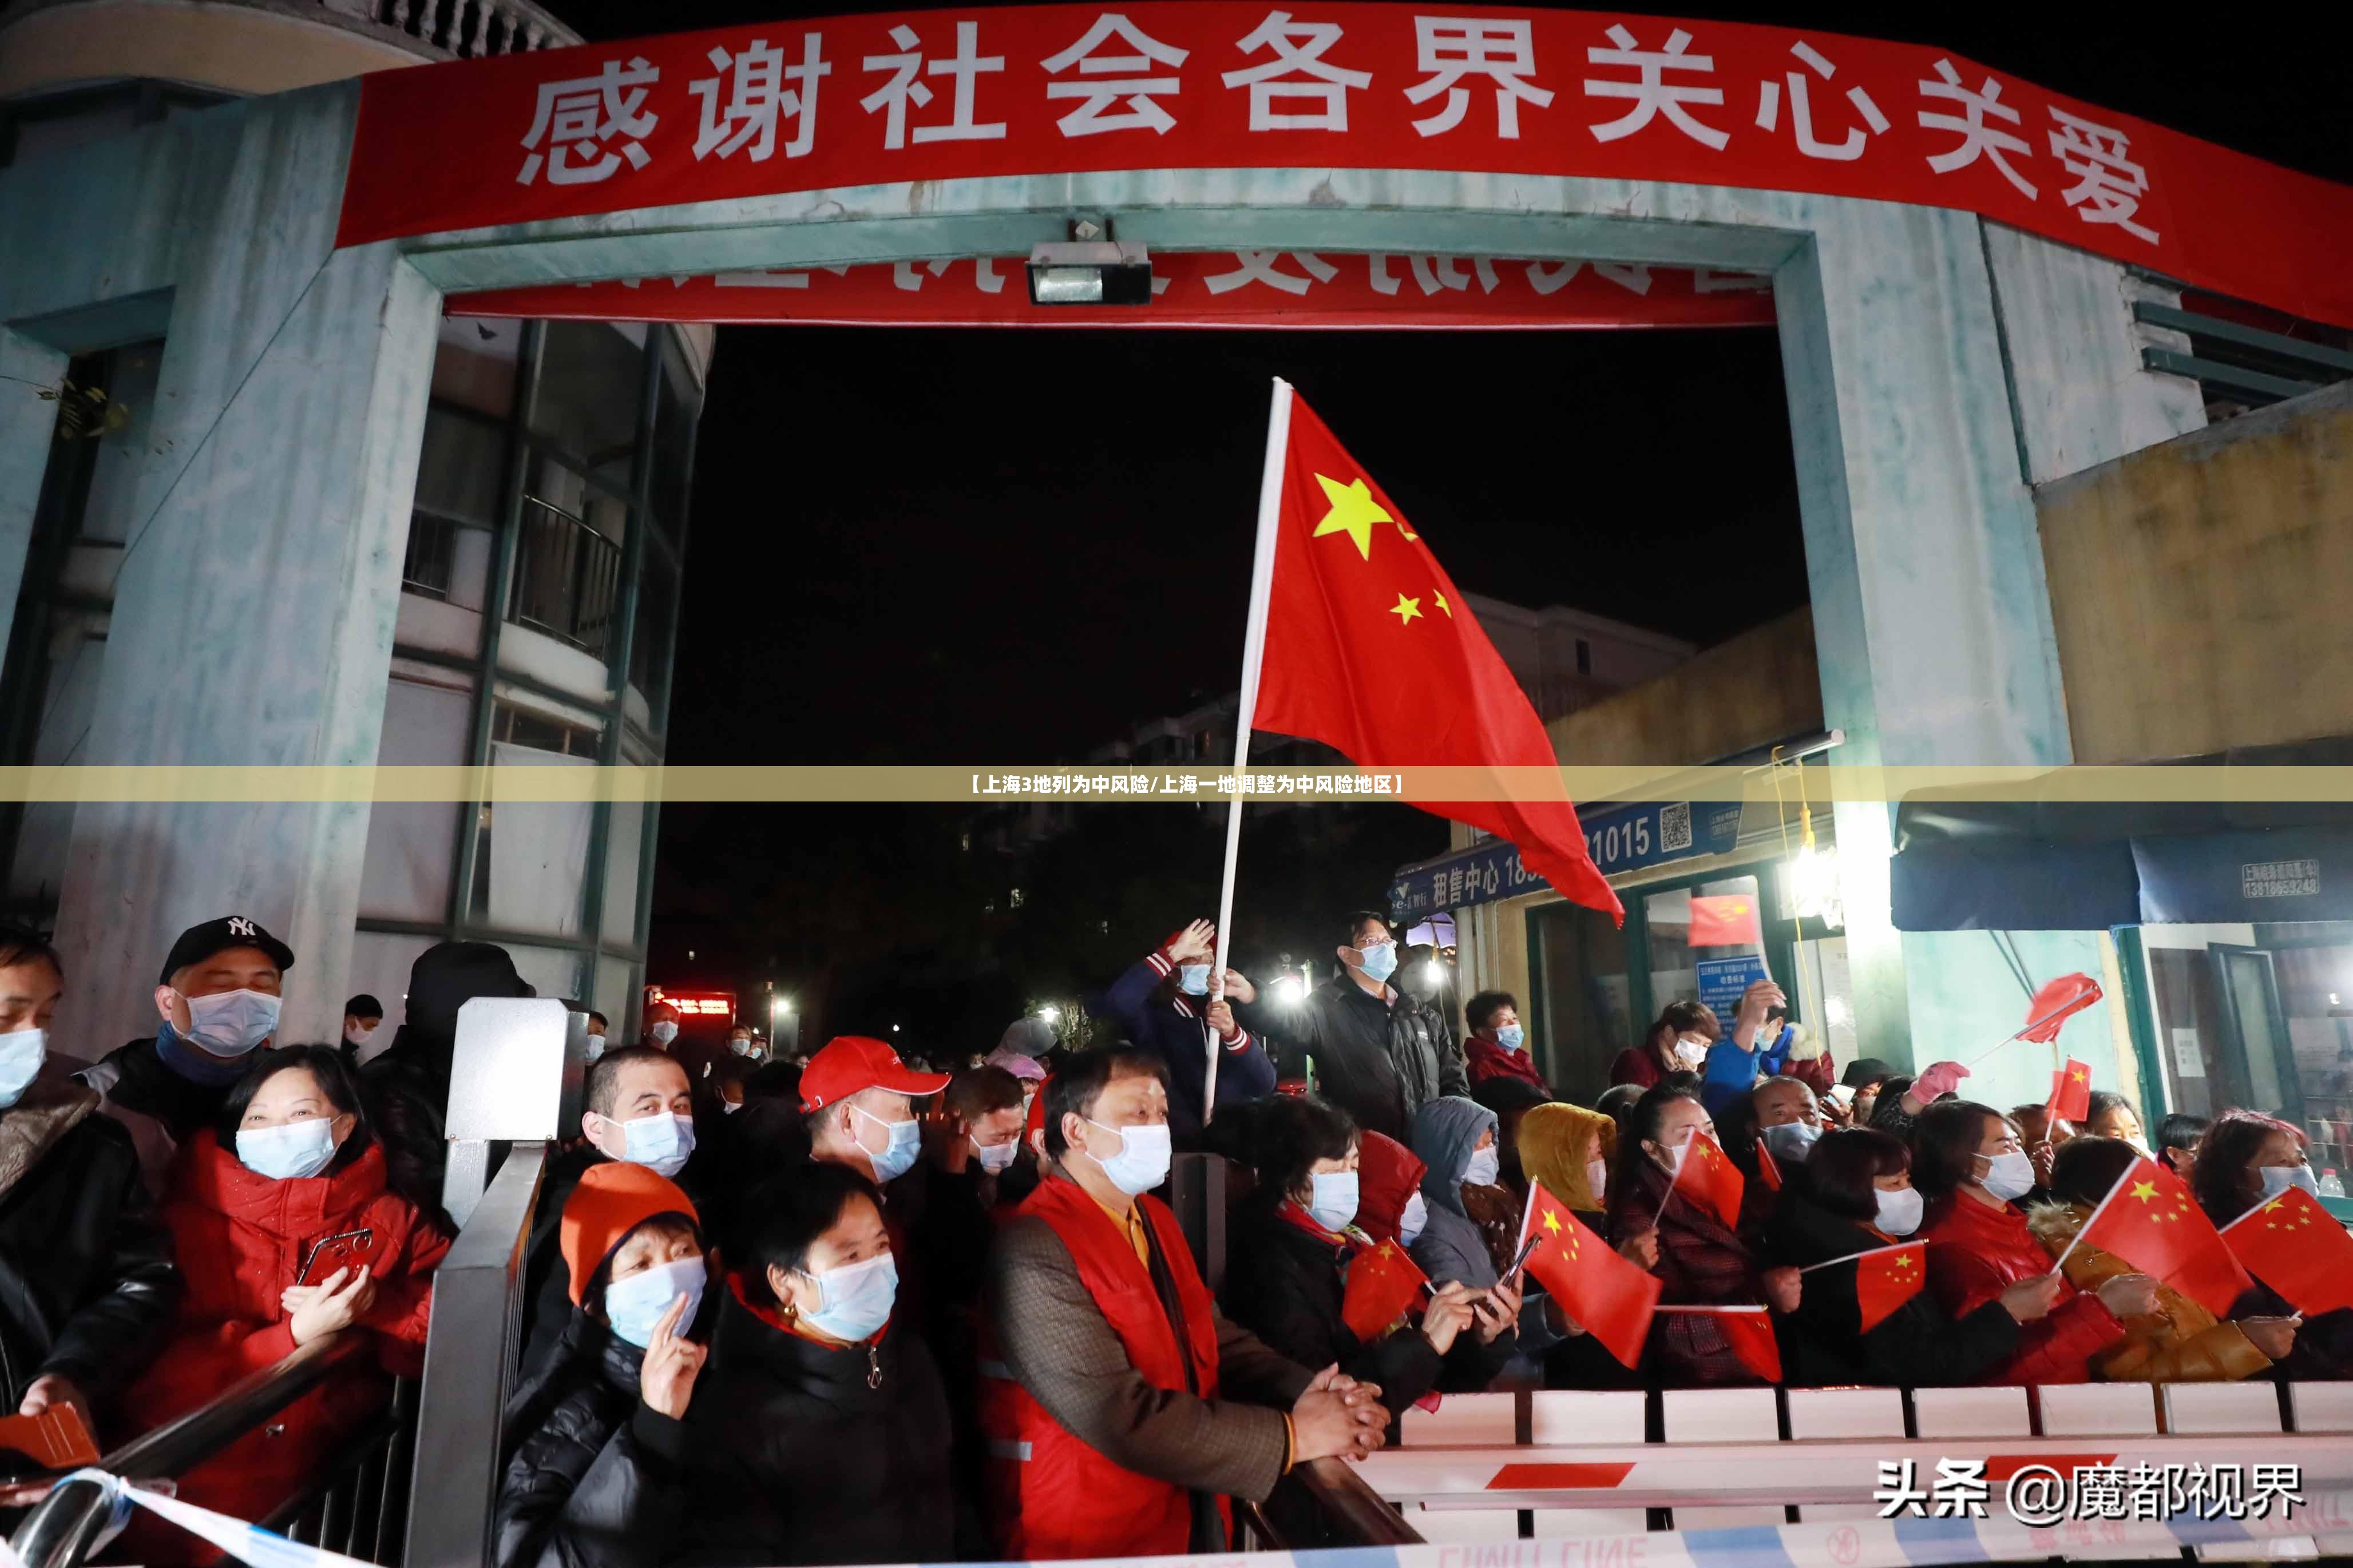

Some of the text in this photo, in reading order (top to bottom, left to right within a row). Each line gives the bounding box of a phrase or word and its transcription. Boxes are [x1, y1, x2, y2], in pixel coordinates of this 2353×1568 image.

[517, 10, 2160, 245] 感谢社会各界关心关爱
[1433, 859, 1499, 908] 租售中心
[228, 917, 255, 936] NY
